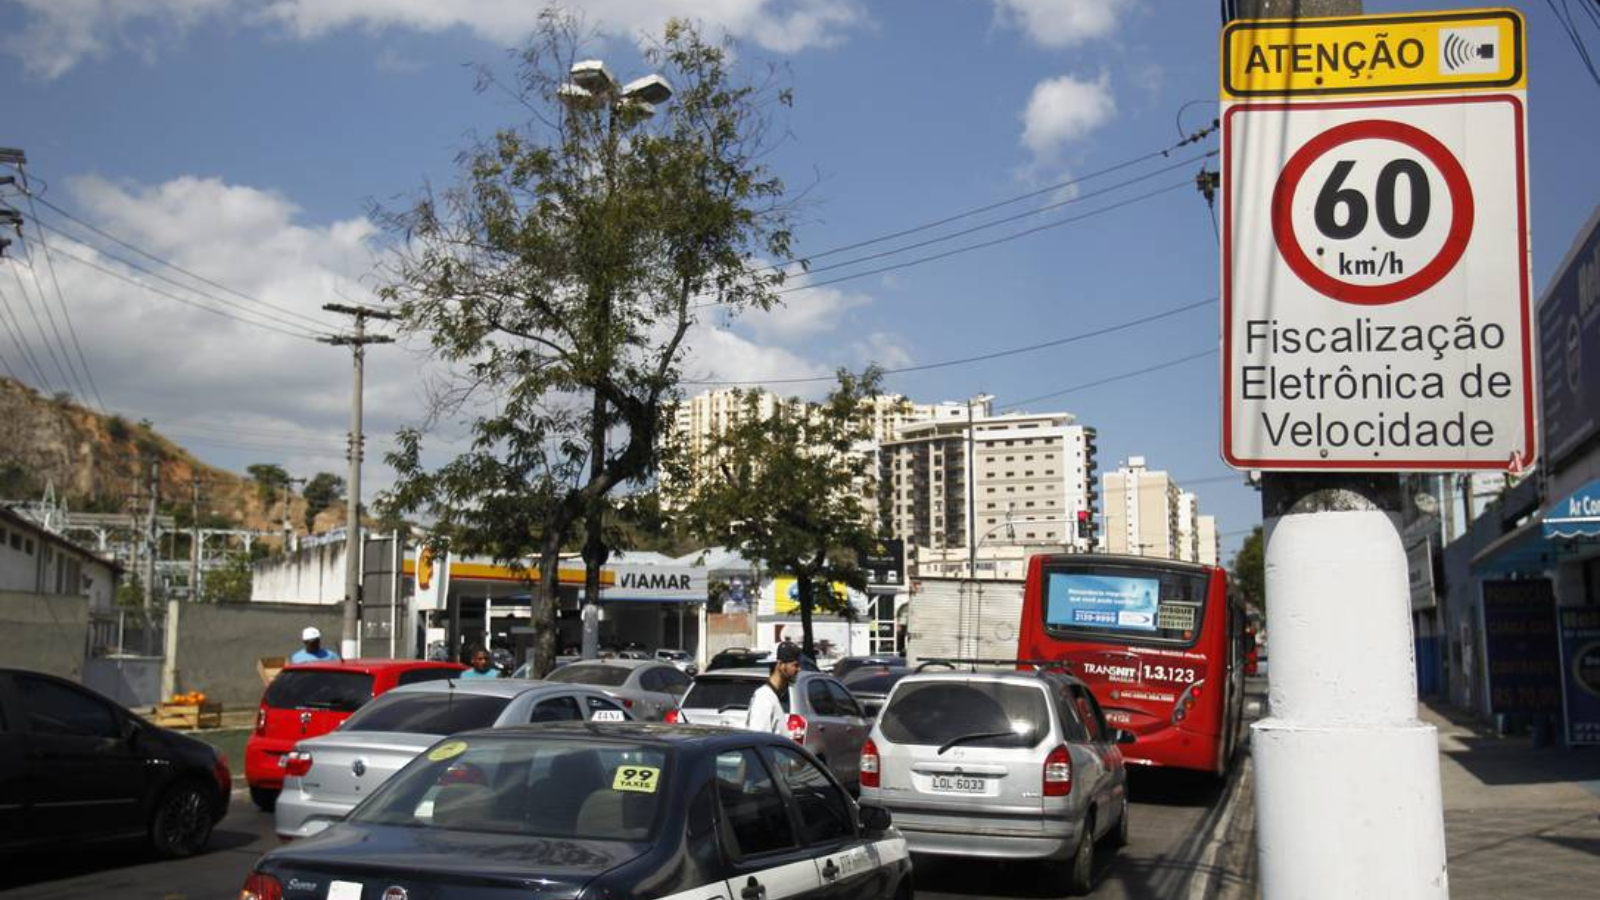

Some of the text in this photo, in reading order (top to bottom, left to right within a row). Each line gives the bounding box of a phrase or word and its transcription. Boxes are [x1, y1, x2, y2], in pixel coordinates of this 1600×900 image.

[1245, 33, 1425, 78] ATENÇÃO
[1314, 158, 1431, 239] 60
[1339, 252, 1404, 277] km/h
[1245, 317, 1505, 360] Fiscalização
[1241, 363, 1512, 401] Eletrônica de
[1261, 411, 1494, 448] Velocidade
[620, 573, 691, 590] VIAMAR
[1084, 663, 1136, 678] TRANSNIT
[1143, 664, 1195, 683] 1.3.123
[620, 781, 651, 789] TAXIS
[623, 769, 653, 781] 99
